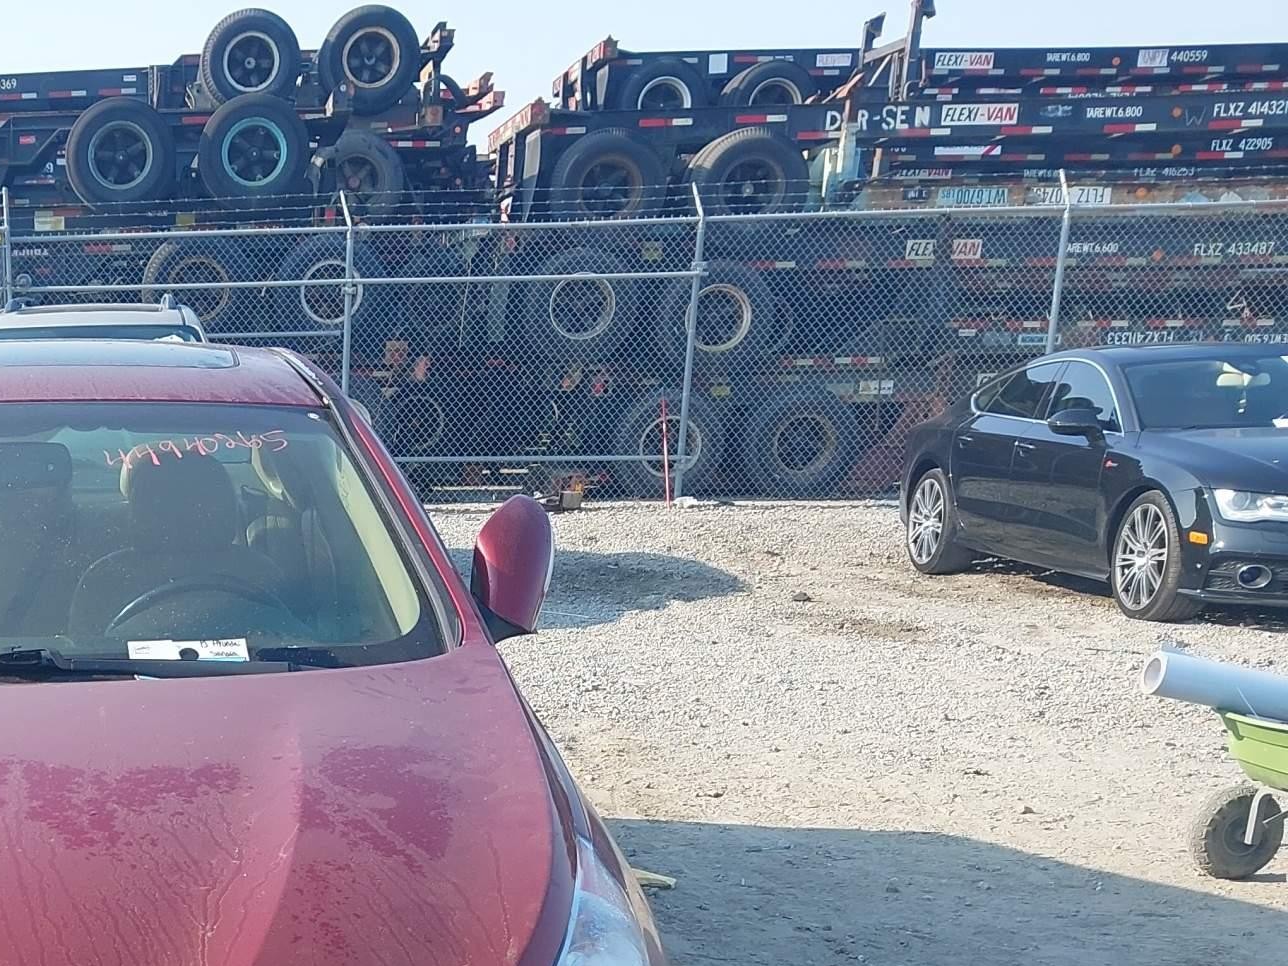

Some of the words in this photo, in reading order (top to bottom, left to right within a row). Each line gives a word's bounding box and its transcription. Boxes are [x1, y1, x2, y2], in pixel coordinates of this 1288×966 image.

[935, 53, 993, 67] FLEXI-VAN
[1170, 50, 1208, 62] 440559
[942, 106, 1017, 122] FLEXI-VAN
[1213, 102, 1244, 118] FLXZ
[1211, 140, 1233, 151] FLXZ
[1238, 137, 1274, 150] 422905
[1193, 243, 1222, 256] FLXZ
[1228, 241, 1276, 256] 433487
